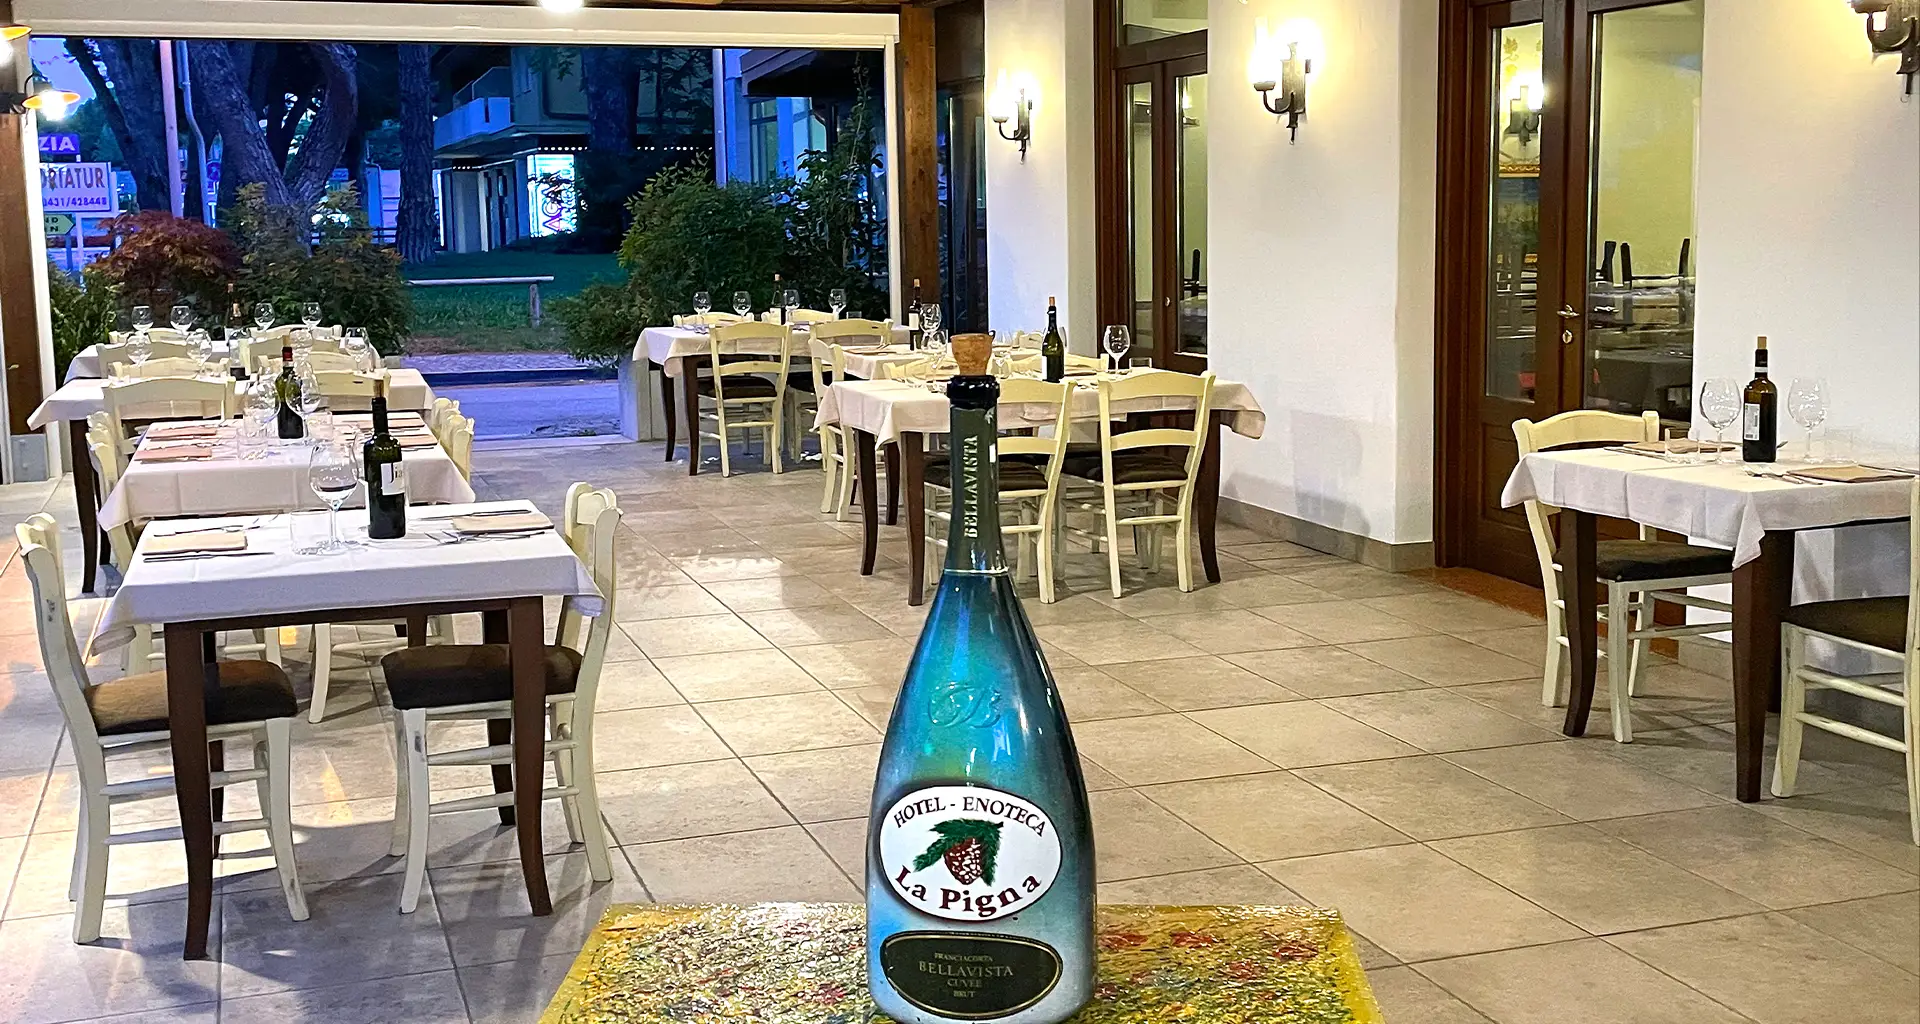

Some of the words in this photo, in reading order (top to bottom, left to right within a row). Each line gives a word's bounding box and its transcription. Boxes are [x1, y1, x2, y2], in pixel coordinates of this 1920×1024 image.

[963, 435, 978, 538] BELLAVISTA
[893, 796, 947, 828] HOTEL
[962, 796, 1046, 837] ENOTECA
[895, 865, 928, 901] La
[939, 874, 1042, 918] Pigna
[918, 960, 1014, 978] BELLAVISTA
